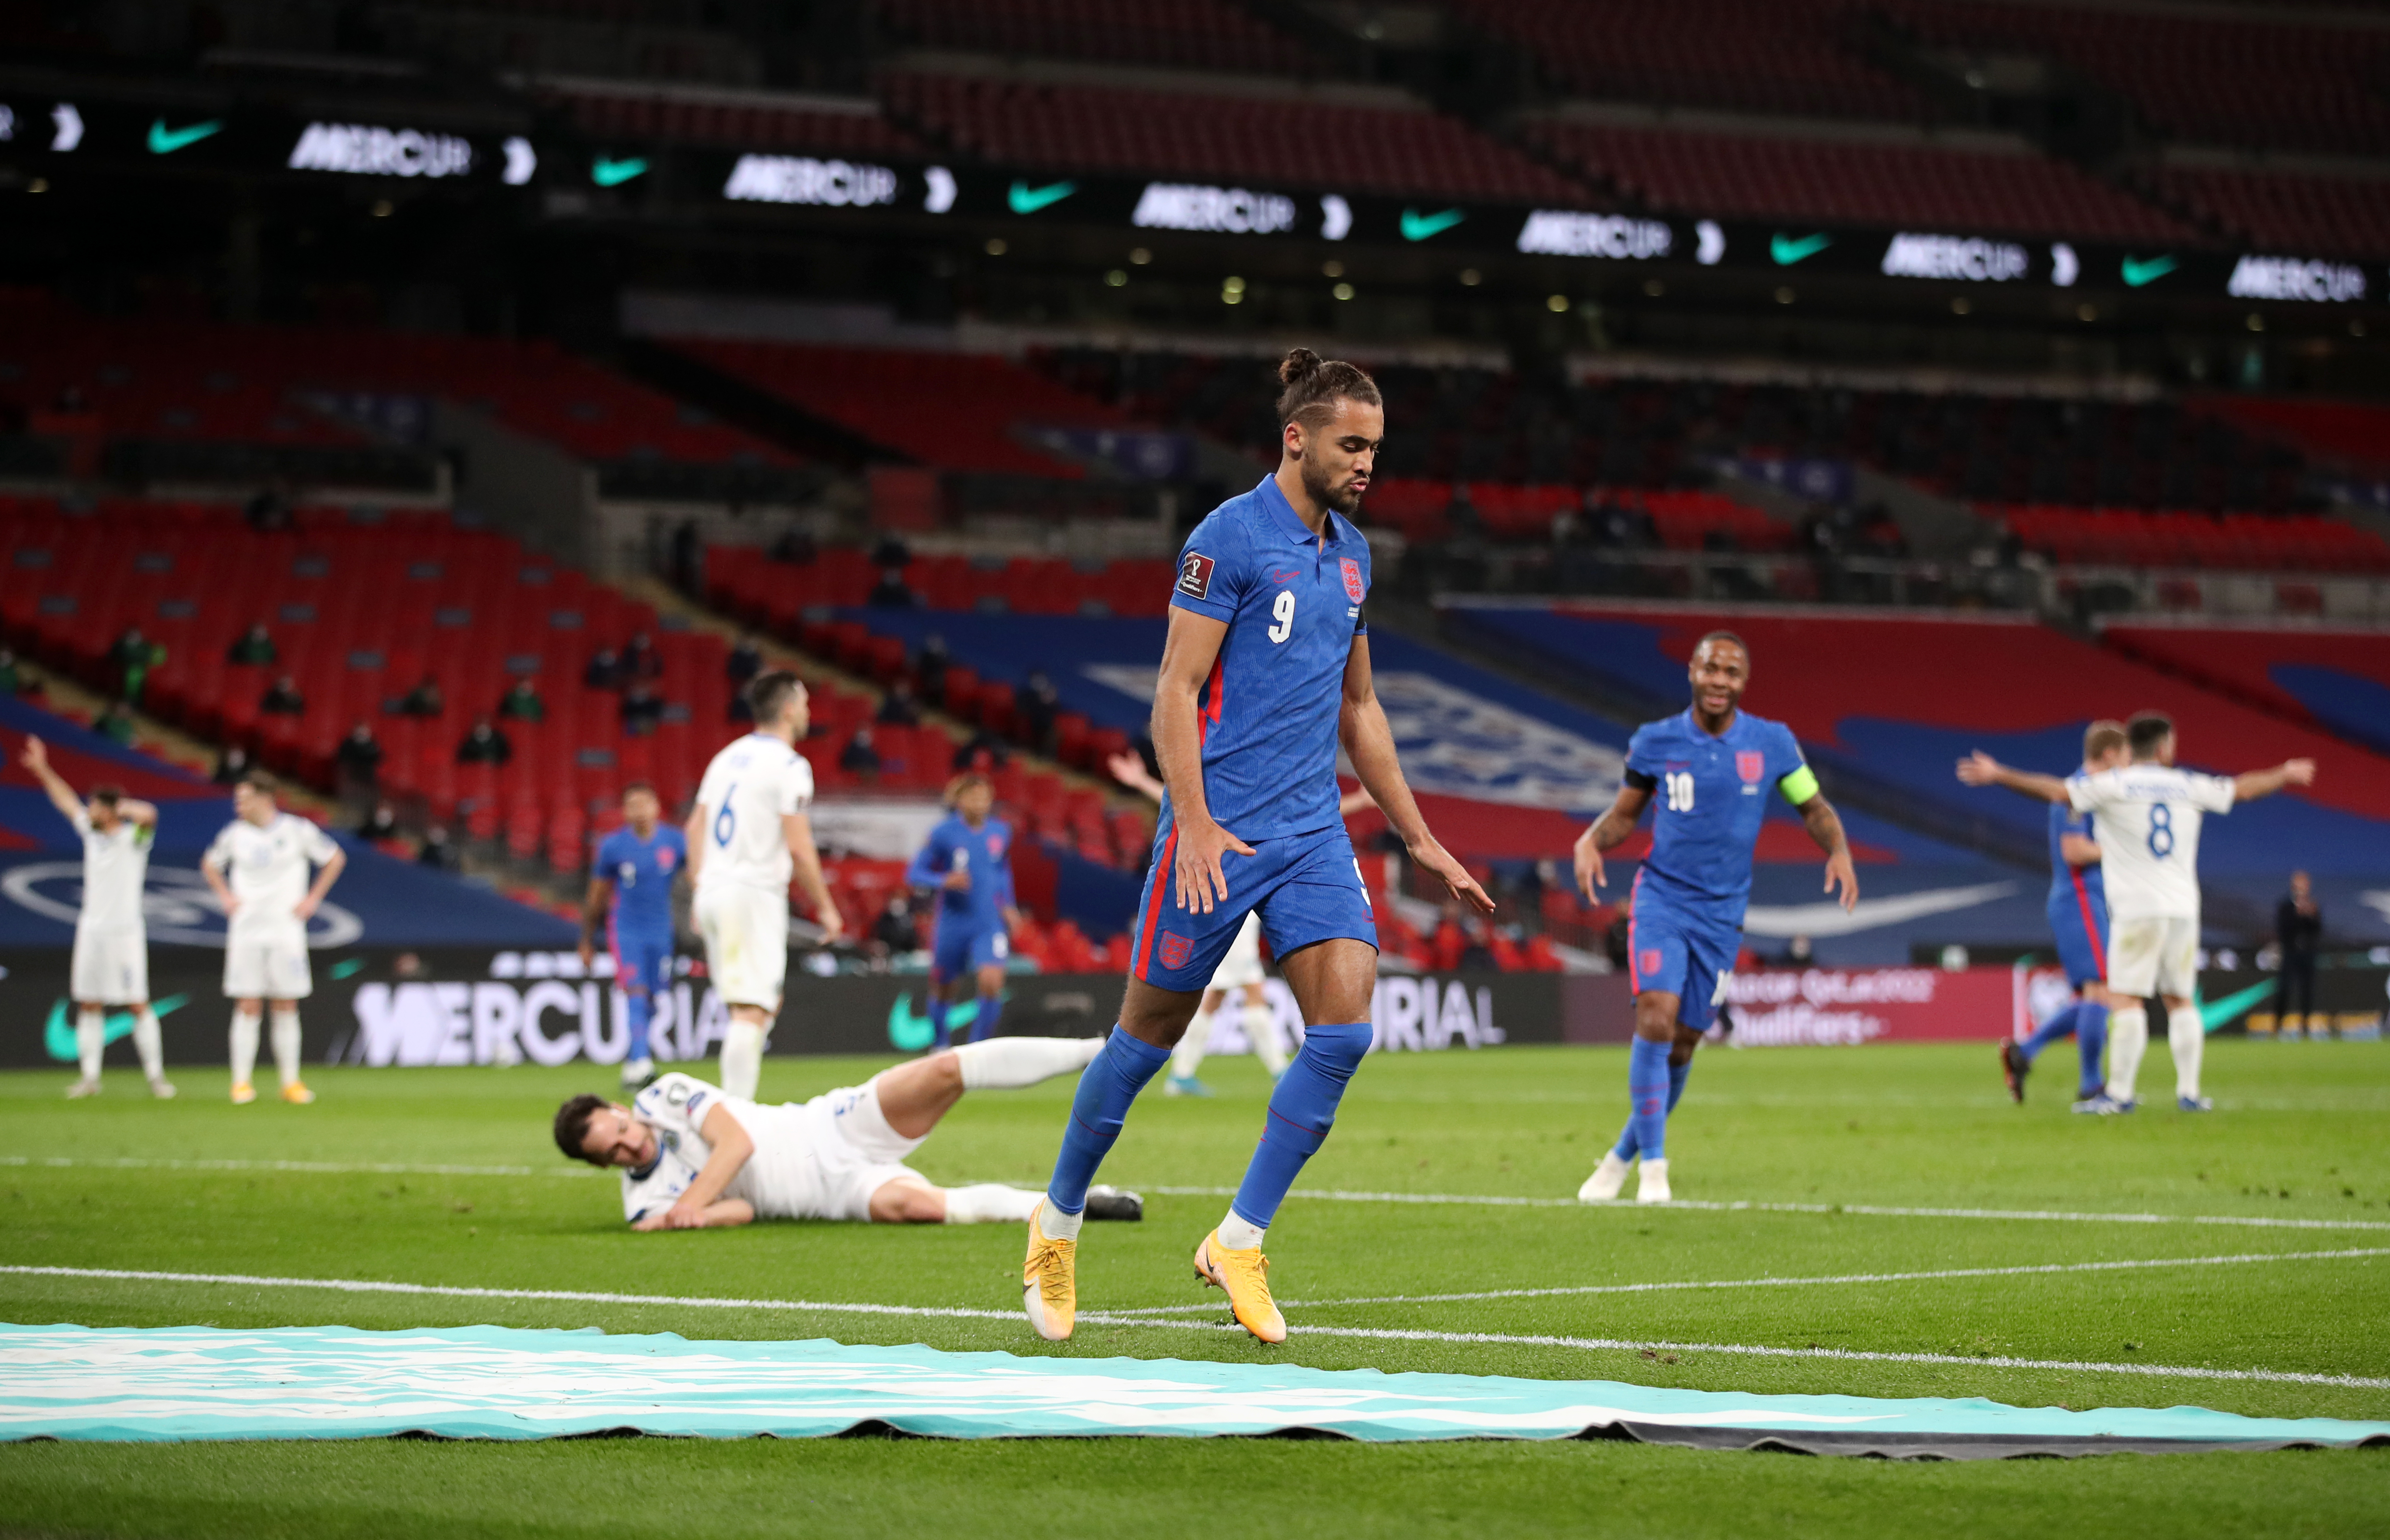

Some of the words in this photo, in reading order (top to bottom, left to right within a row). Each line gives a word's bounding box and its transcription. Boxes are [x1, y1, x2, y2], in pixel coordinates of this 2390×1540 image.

[1268, 590, 1295, 644] 9
[714, 783, 738, 848] 6
[1665, 771, 1694, 812] 10
[2148, 803, 2175, 859] 8
